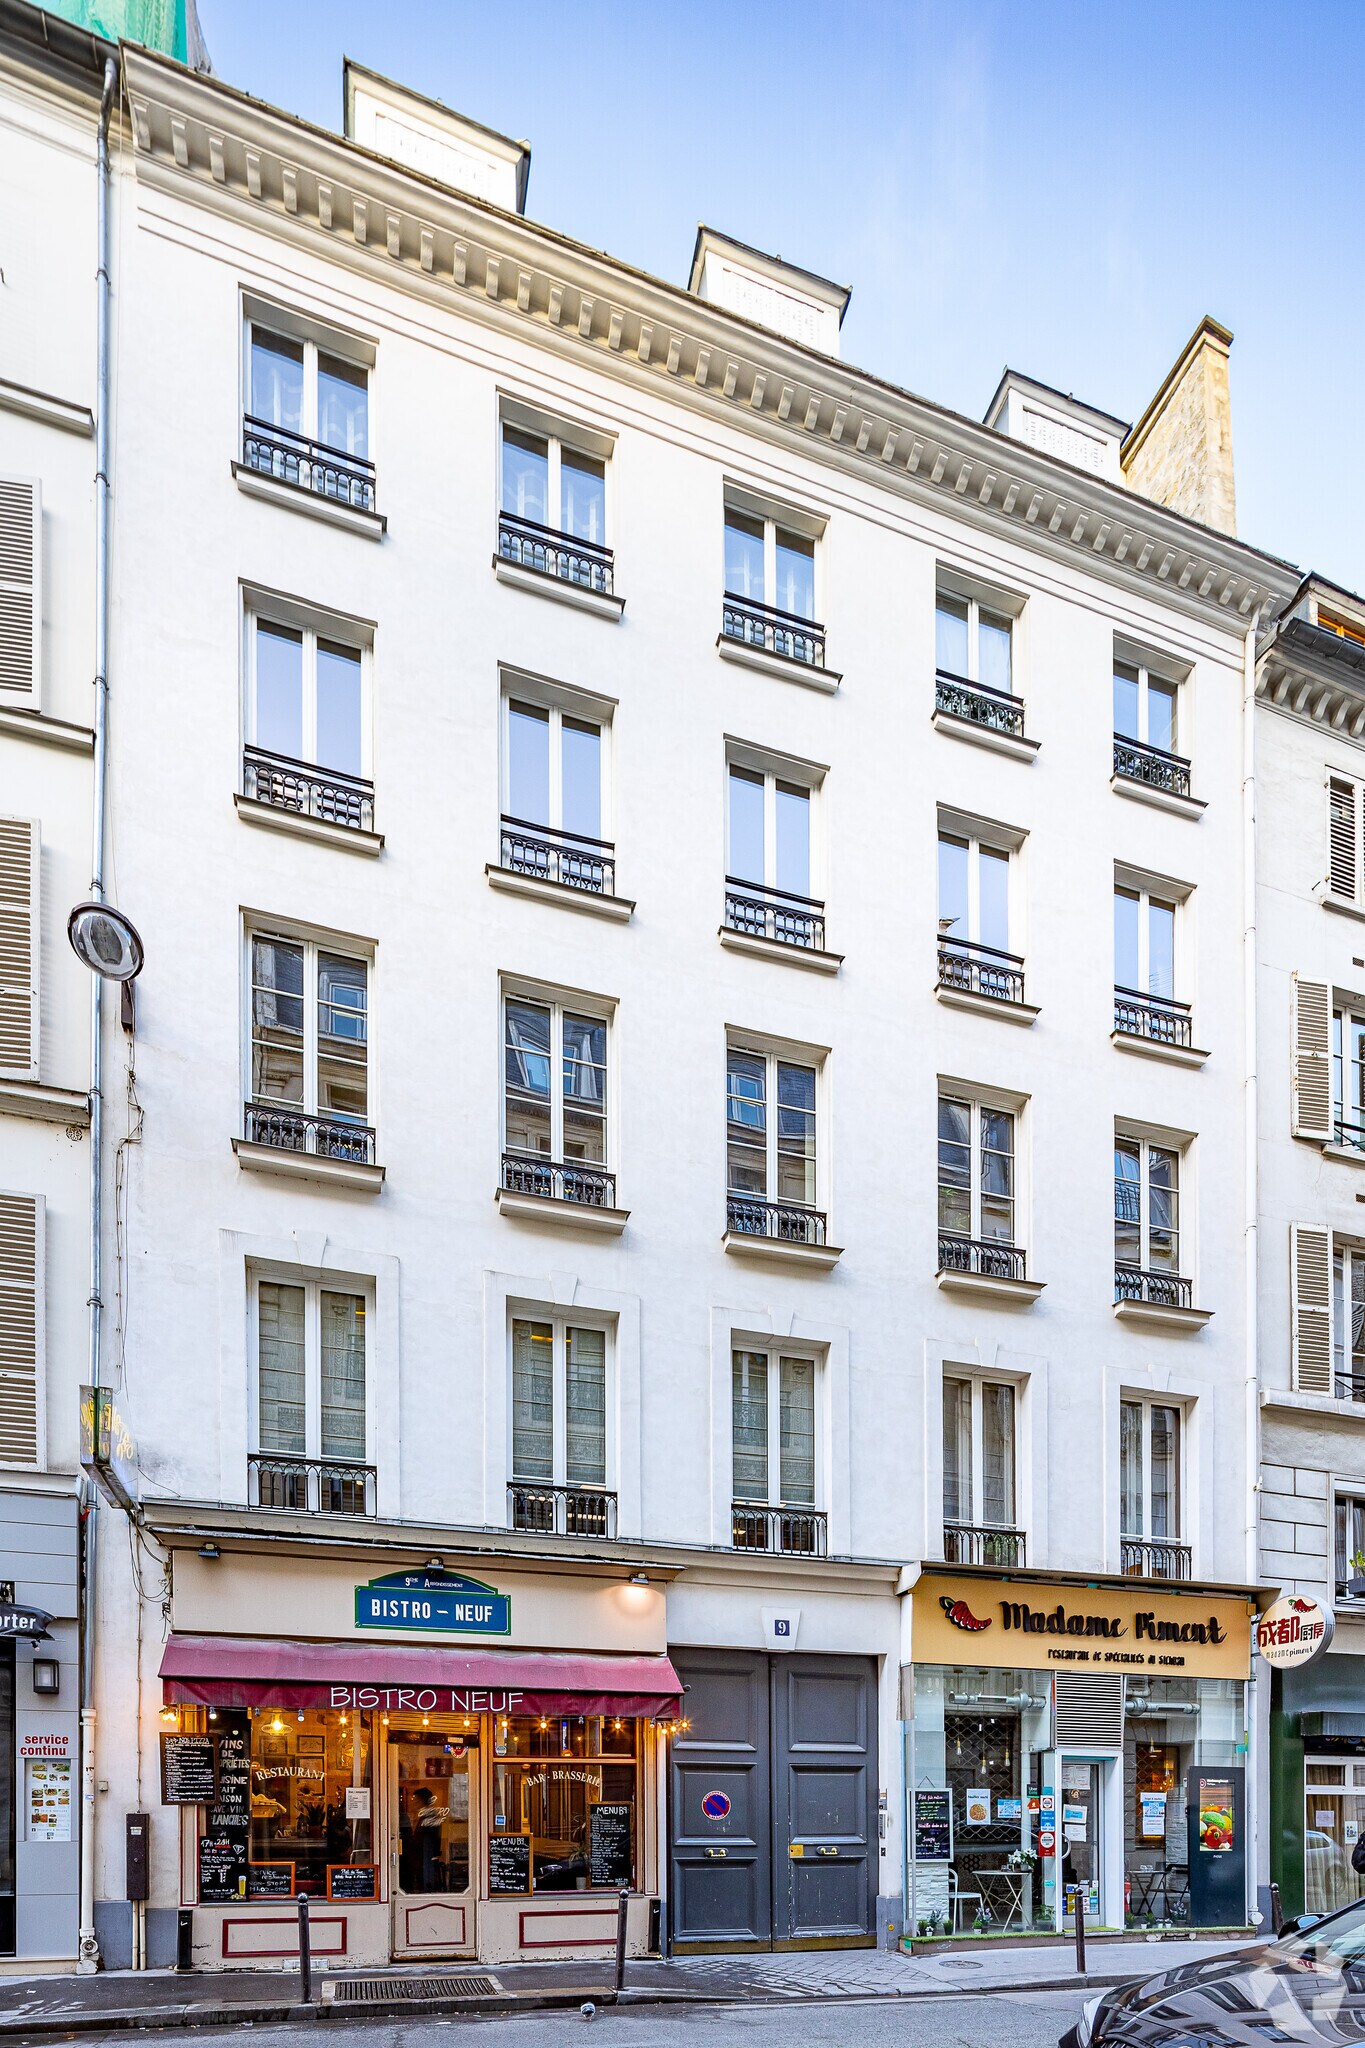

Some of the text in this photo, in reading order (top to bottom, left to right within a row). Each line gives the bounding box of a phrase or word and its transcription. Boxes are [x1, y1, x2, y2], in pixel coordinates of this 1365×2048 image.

[371, 1598, 431, 1619] BISTRO
[455, 1604, 493, 1622] NEUF
[0, 1613, 36, 1629] rter
[777, 1621, 787, 1635] 9
[999, 1601, 1228, 1644] Madame Piment
[1257, 1615, 1325, 1648] 成都厨房
[330, 1687, 524, 1712] BISTRO NEUF
[25, 1734, 69, 1745] service
[20, 1746, 66, 1756] continu
[255, 1766, 327, 1782] RESTAURANT
[526, 1773, 546, 1787] BAR
[552, 1770, 601, 1788] BRASSERIE
[597, 1806, 618, 1815] MENU
[496, 1838, 516, 1846] MENU
